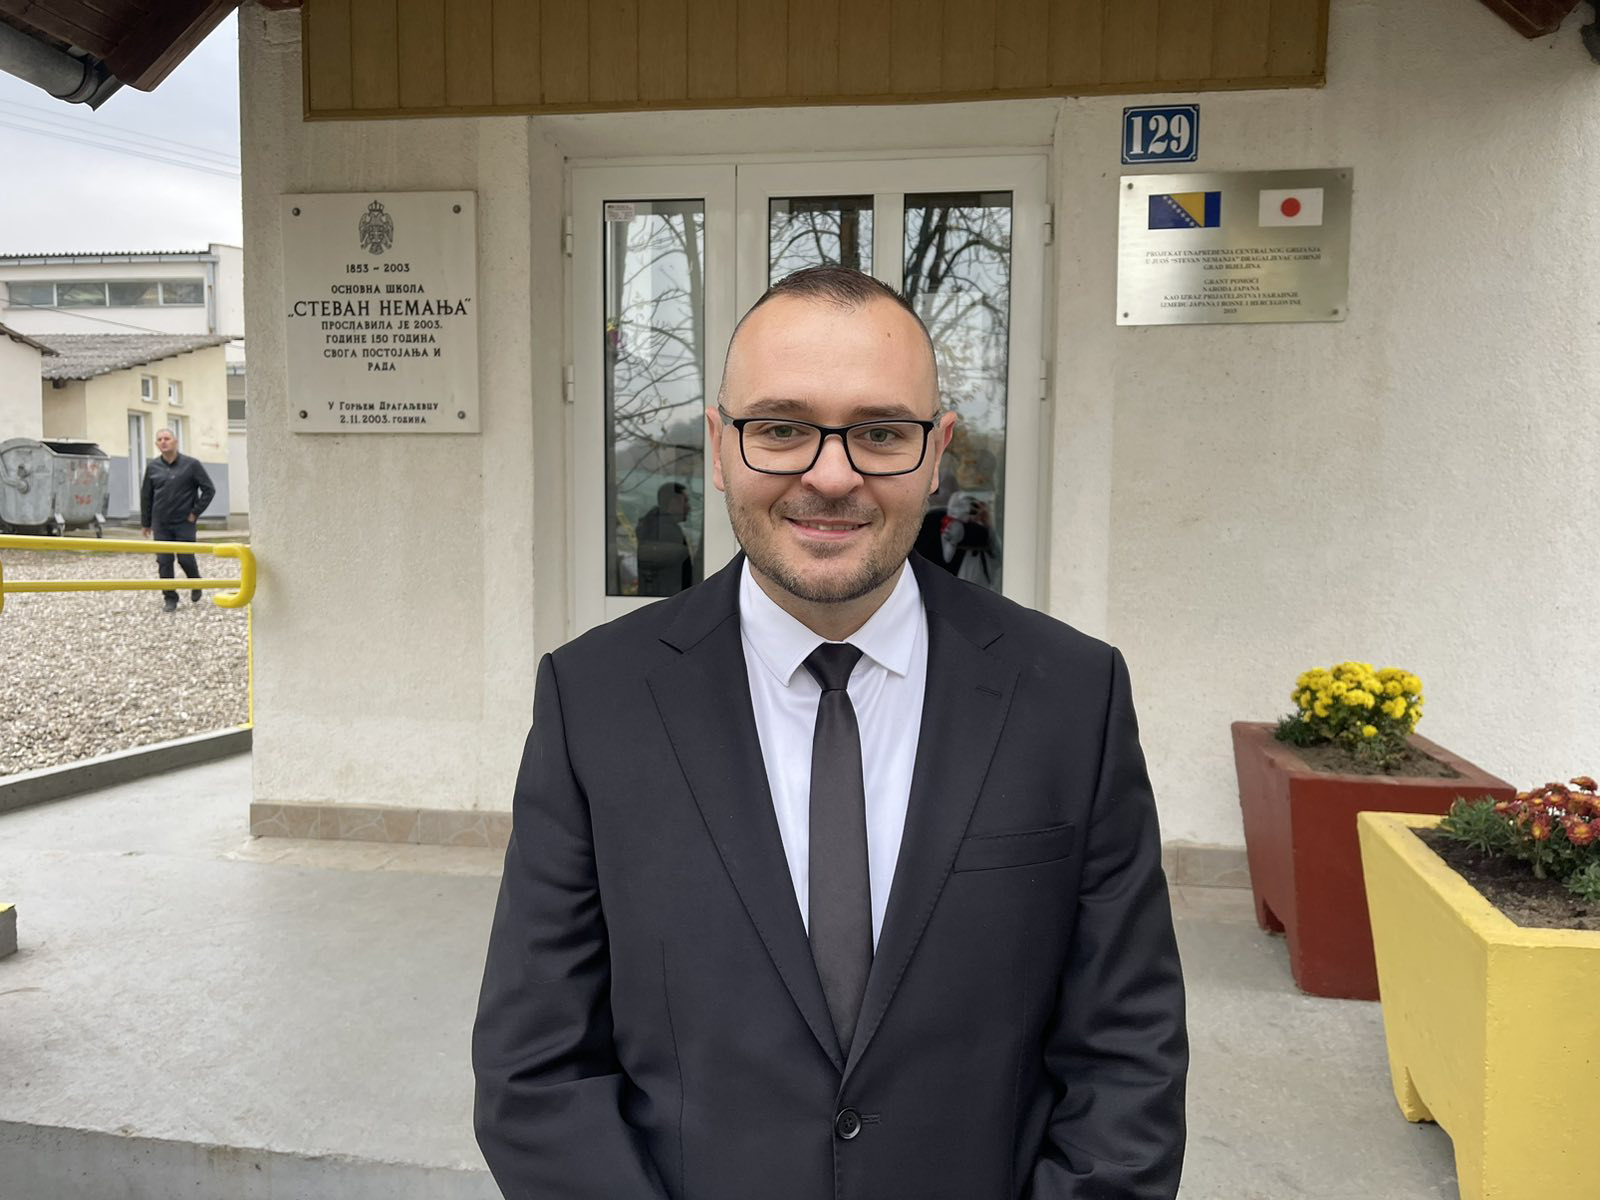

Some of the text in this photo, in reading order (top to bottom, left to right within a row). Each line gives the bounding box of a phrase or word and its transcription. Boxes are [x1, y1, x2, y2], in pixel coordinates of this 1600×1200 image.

[1130, 115, 1190, 155] 129
[346, 264, 369, 273] 1853
[384, 264, 410, 272] 2003
[331, 284, 424, 294] ОСНОВНА ШКОЛА
[288, 301, 370, 318] „СТЕВАН
[322, 320, 443, 330] ПРОСЛАВИЛА ЈЕ 2003.
[326, 334, 436, 343] ГОДИНЕ 150 ГОДИНА
[324, 348, 440, 358] СВОГА ПОСТОЈАЊА И
[368, 362, 396, 371] РАДА
[328, 402, 334, 410] У
[340, 415, 390, 424] 2.11.2003.
